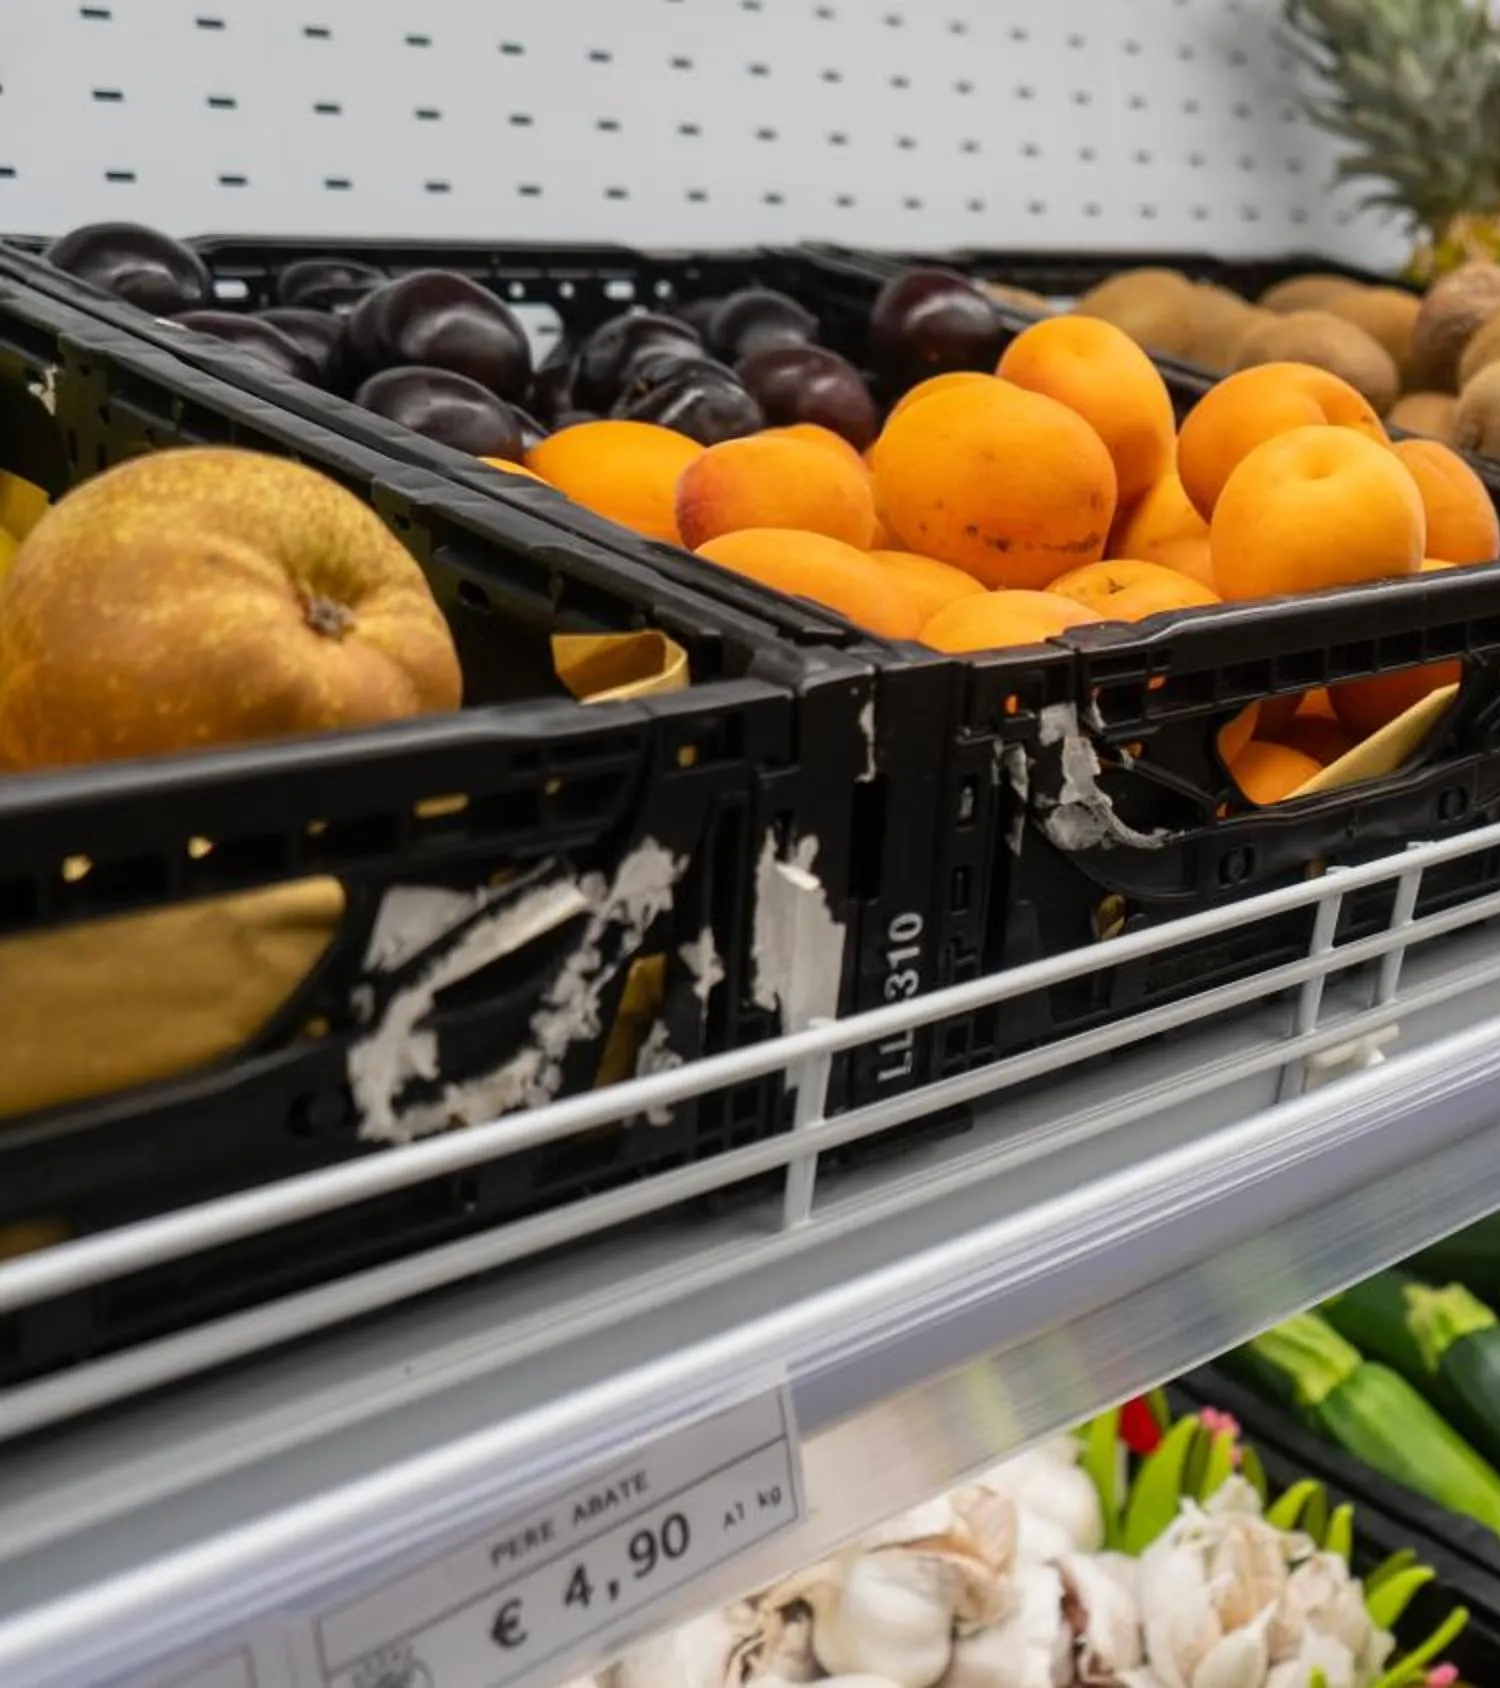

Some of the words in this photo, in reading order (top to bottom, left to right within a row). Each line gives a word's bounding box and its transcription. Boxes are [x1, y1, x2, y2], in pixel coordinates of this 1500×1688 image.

[490, 1517, 555, 1567] PERE
[573, 1470, 650, 1527] ABATE
[491, 1596, 529, 1647] €
[563, 1512, 691, 1608] 4,90
